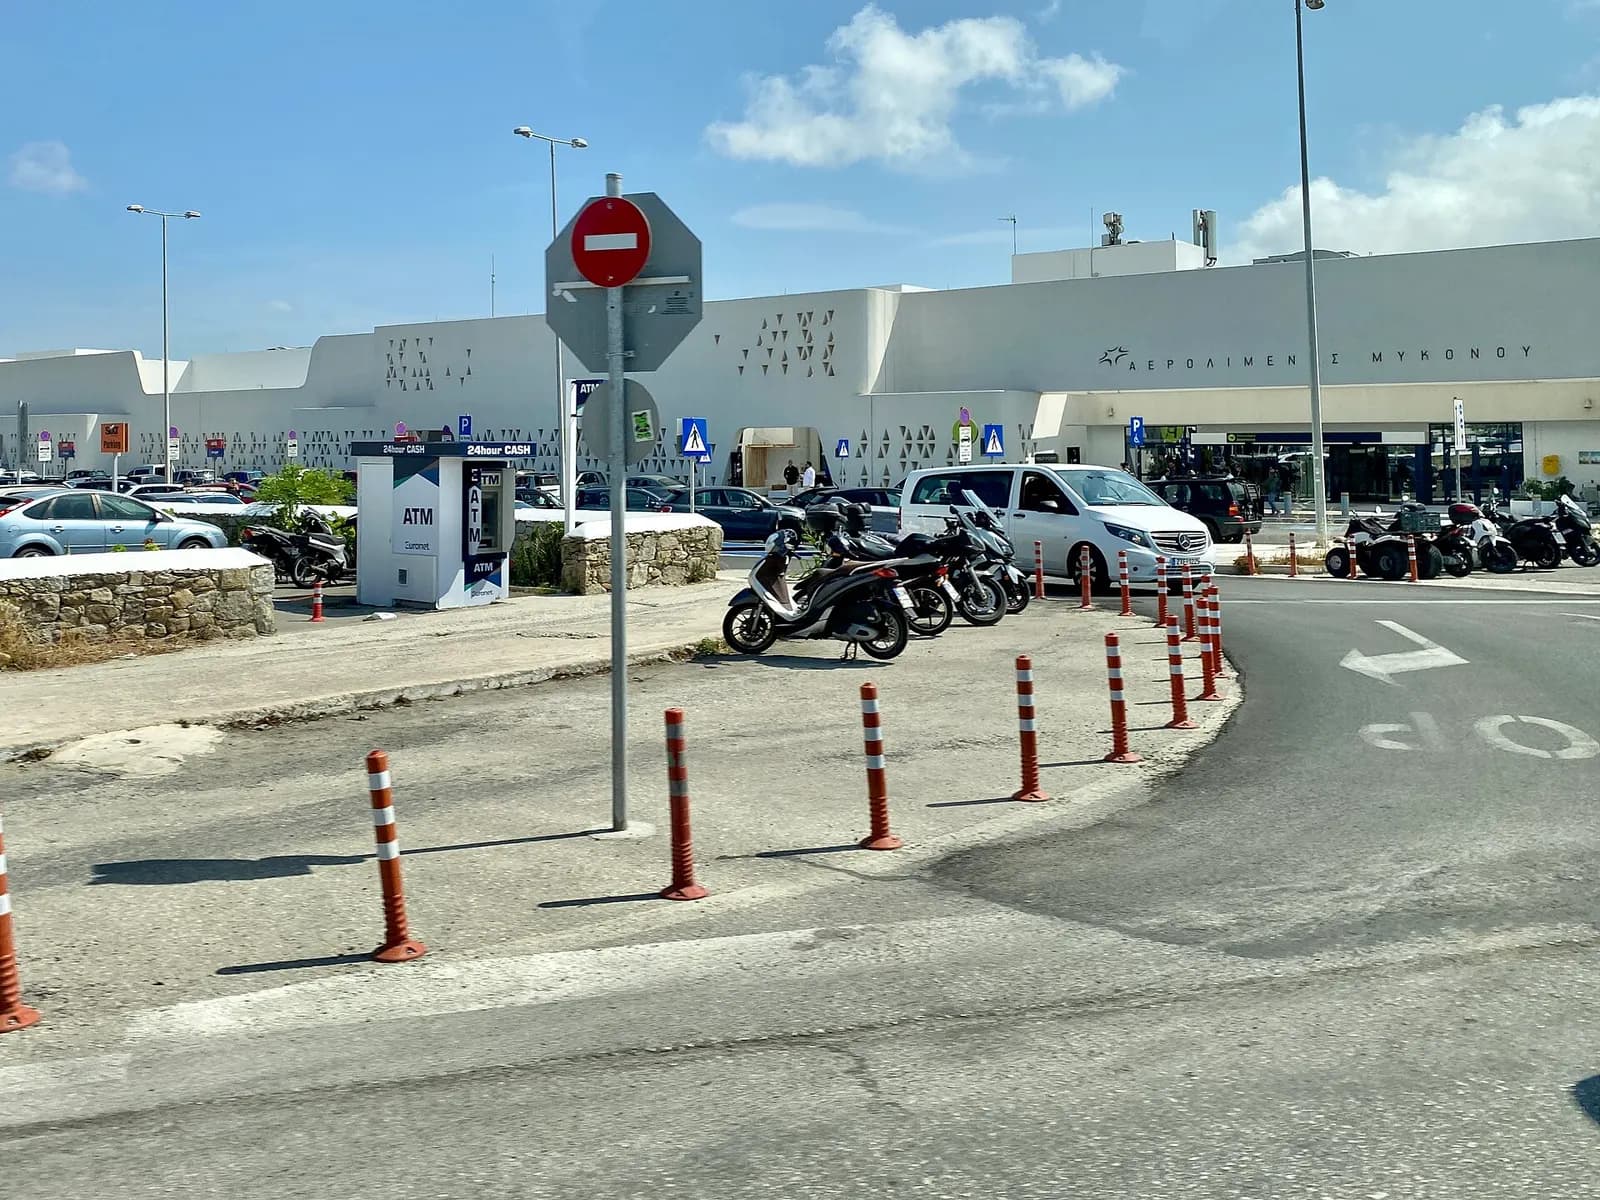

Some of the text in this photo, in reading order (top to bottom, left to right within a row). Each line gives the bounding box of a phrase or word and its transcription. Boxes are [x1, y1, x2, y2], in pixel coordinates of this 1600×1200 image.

[1128, 345, 1531, 371] ΑΕΡΟΛΙΜΕΝΣ ΜΥΚΟΝΟΥ
[461, 417, 469, 433] P
[1133, 419, 1140, 432] P
[383, 445, 425, 454] 24hour CASH
[467, 445, 531, 455] 24hour CASH
[403, 507, 433, 526] ATM
[469, 489, 480, 542] ATM
[473, 562, 494, 573] ATM
